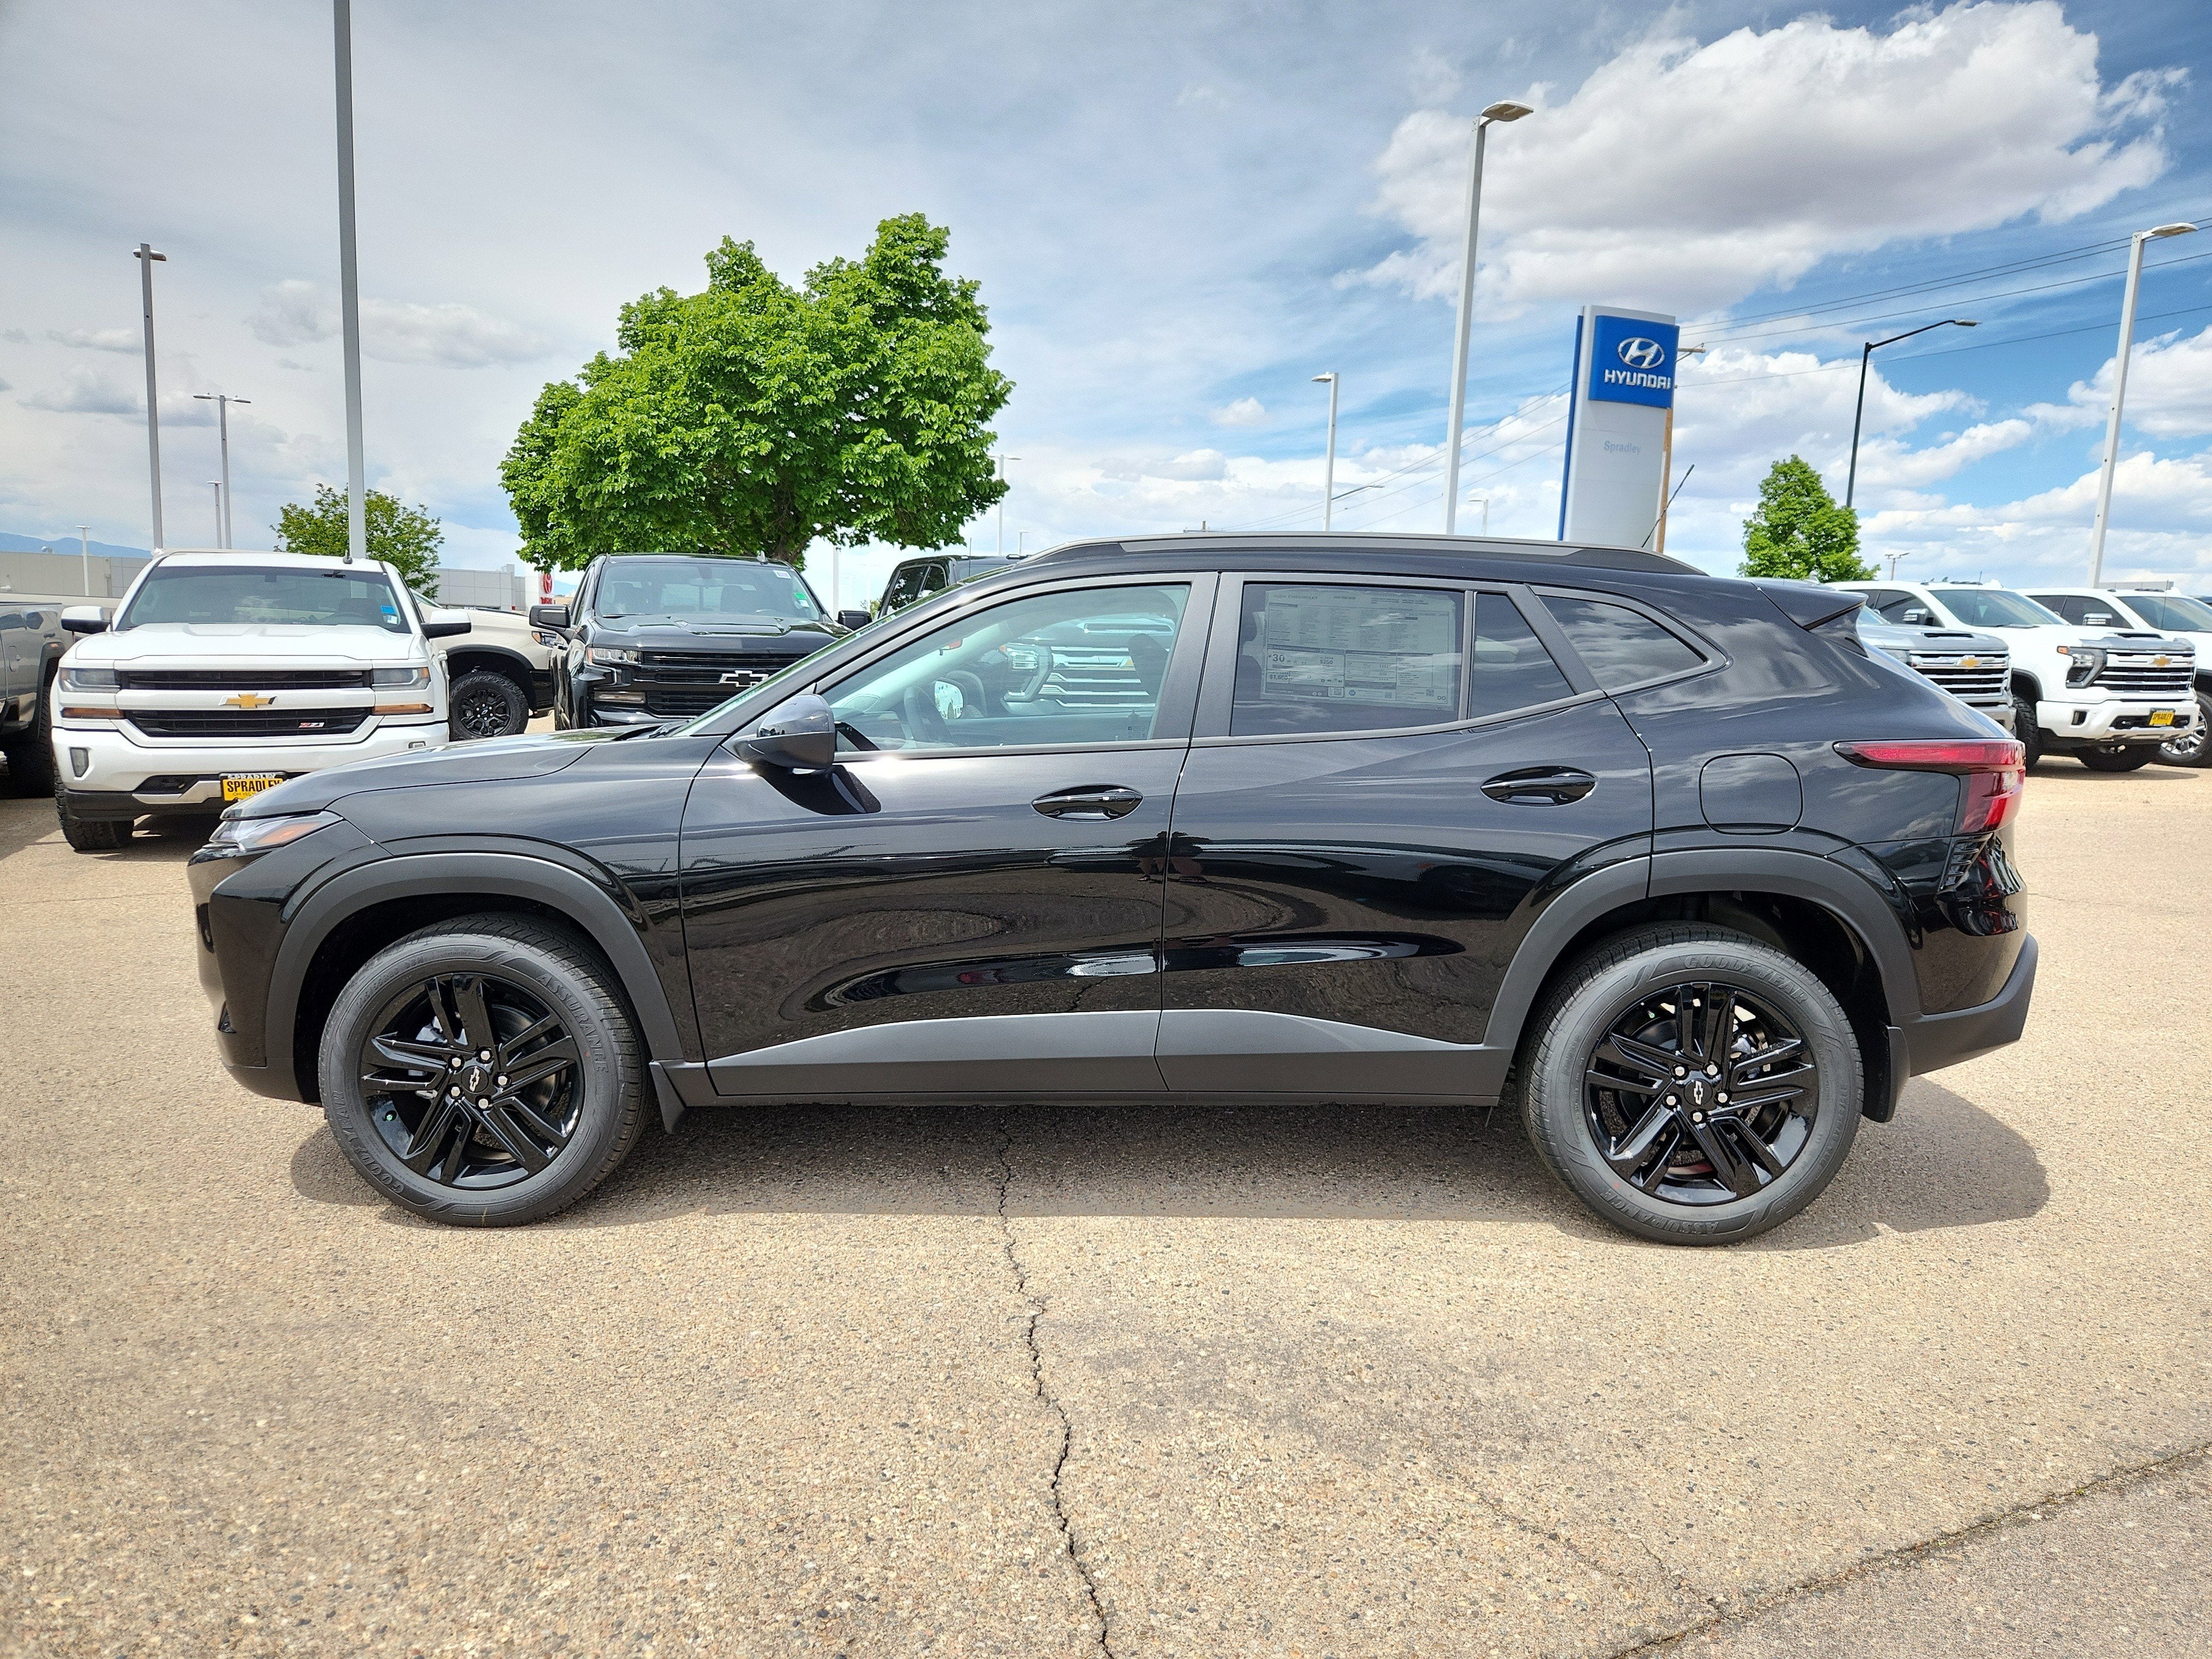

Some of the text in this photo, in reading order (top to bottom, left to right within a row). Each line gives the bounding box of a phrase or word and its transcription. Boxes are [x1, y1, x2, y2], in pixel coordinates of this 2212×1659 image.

[1605, 369, 1671, 389] HYUNDAI
[1604, 440, 1641, 454] Spradley
[1272, 654, 1285, 662] 30
